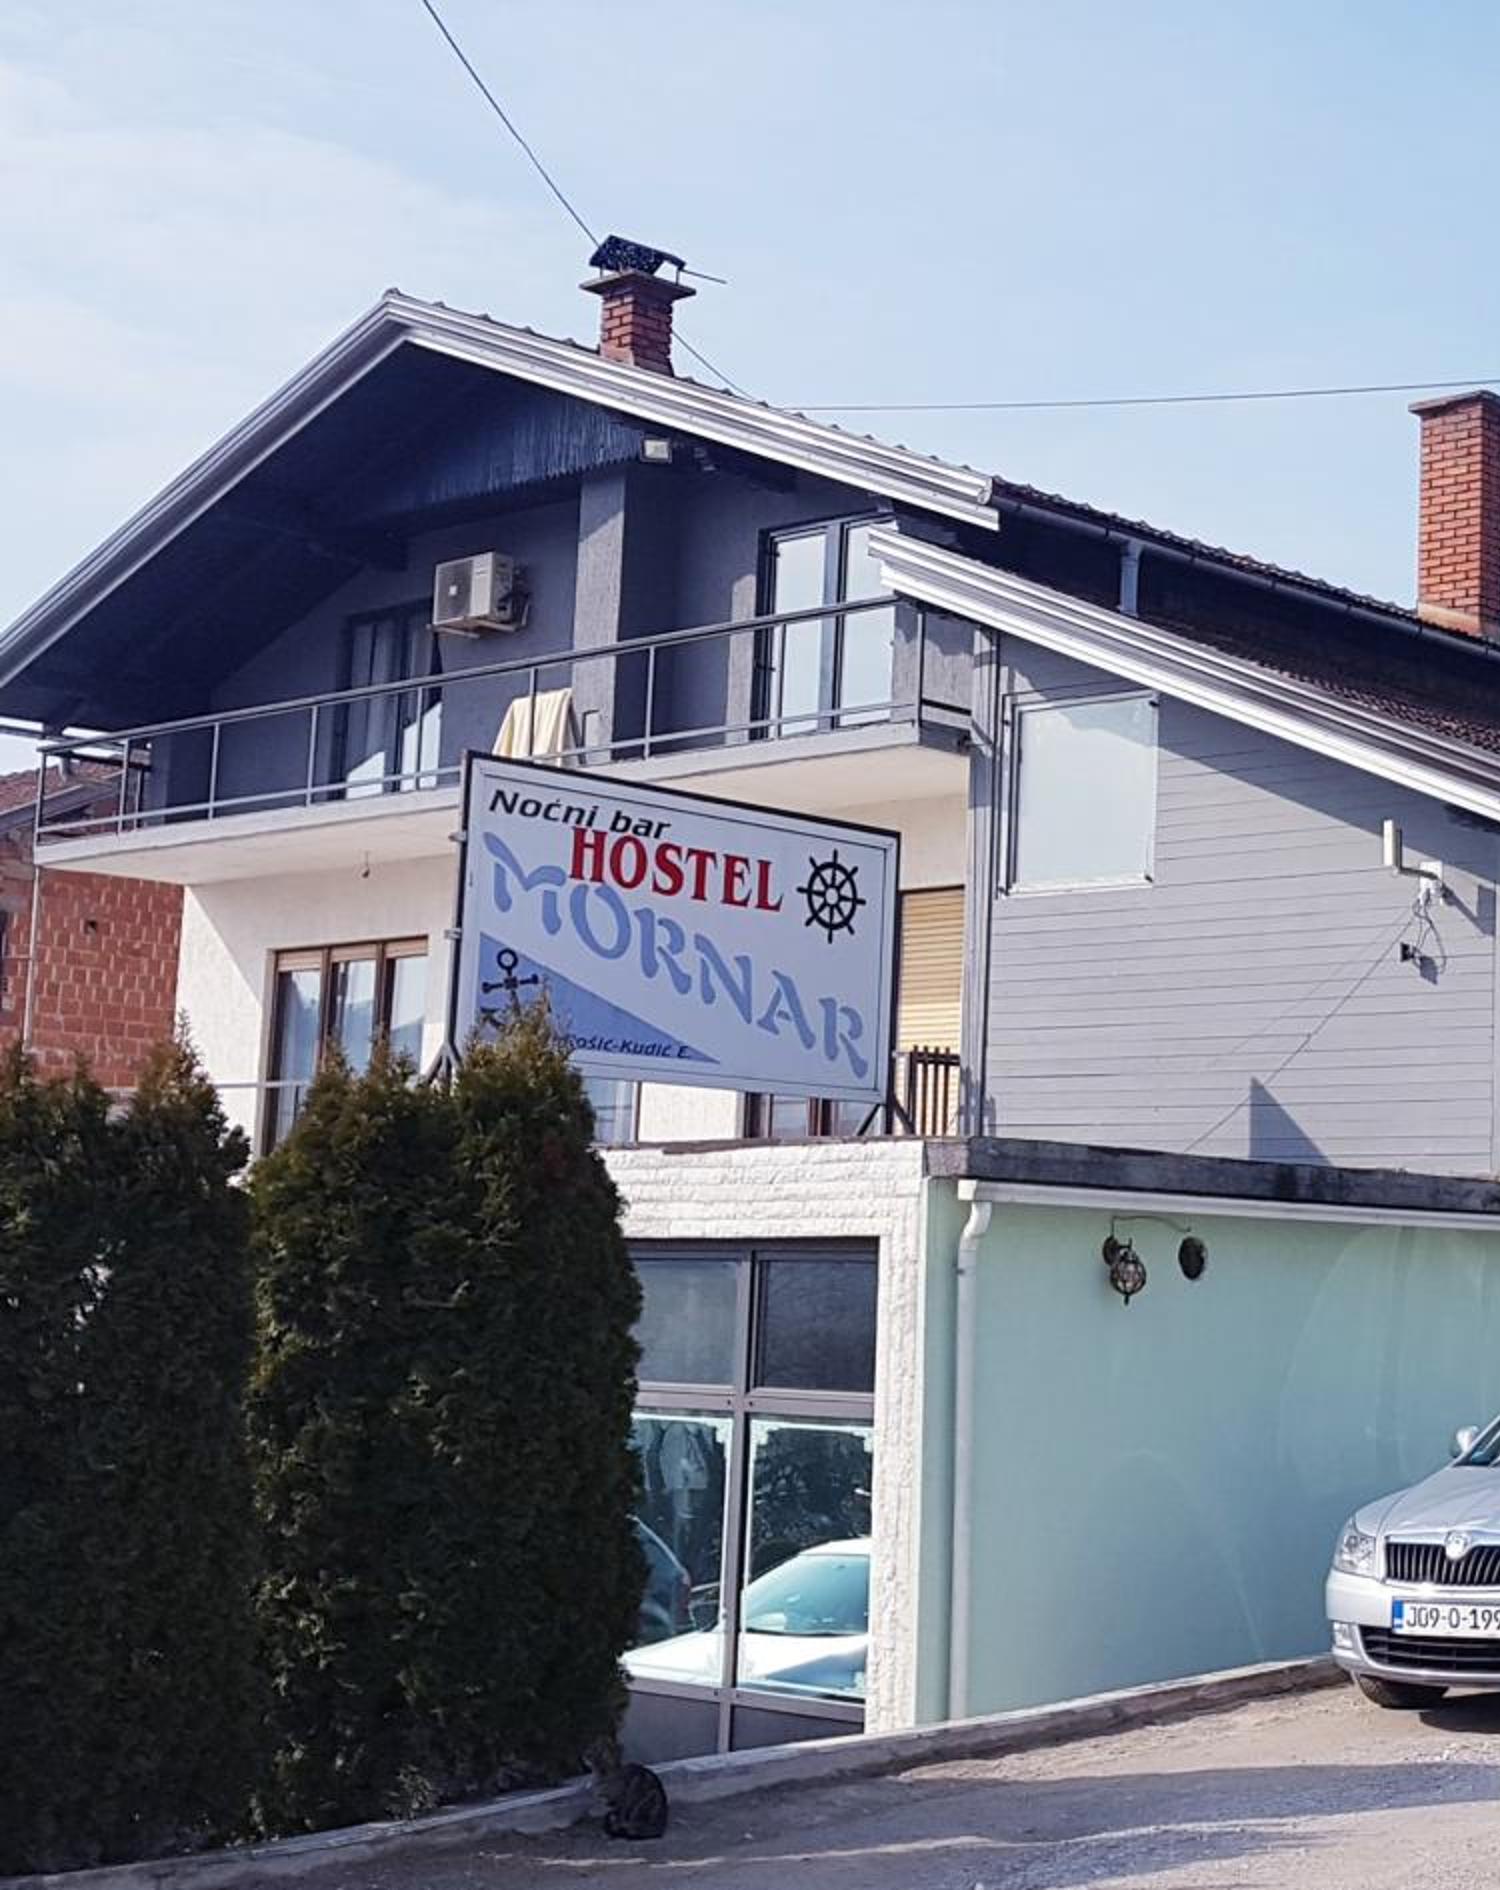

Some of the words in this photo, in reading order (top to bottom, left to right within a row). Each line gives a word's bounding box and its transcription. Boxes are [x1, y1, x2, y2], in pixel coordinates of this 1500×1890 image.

[489, 789, 599, 828] Noćni
[609, 810, 672, 840] bar
[569, 826, 785, 913] HOSTEL
[483, 832, 869, 1080] MORNAR
